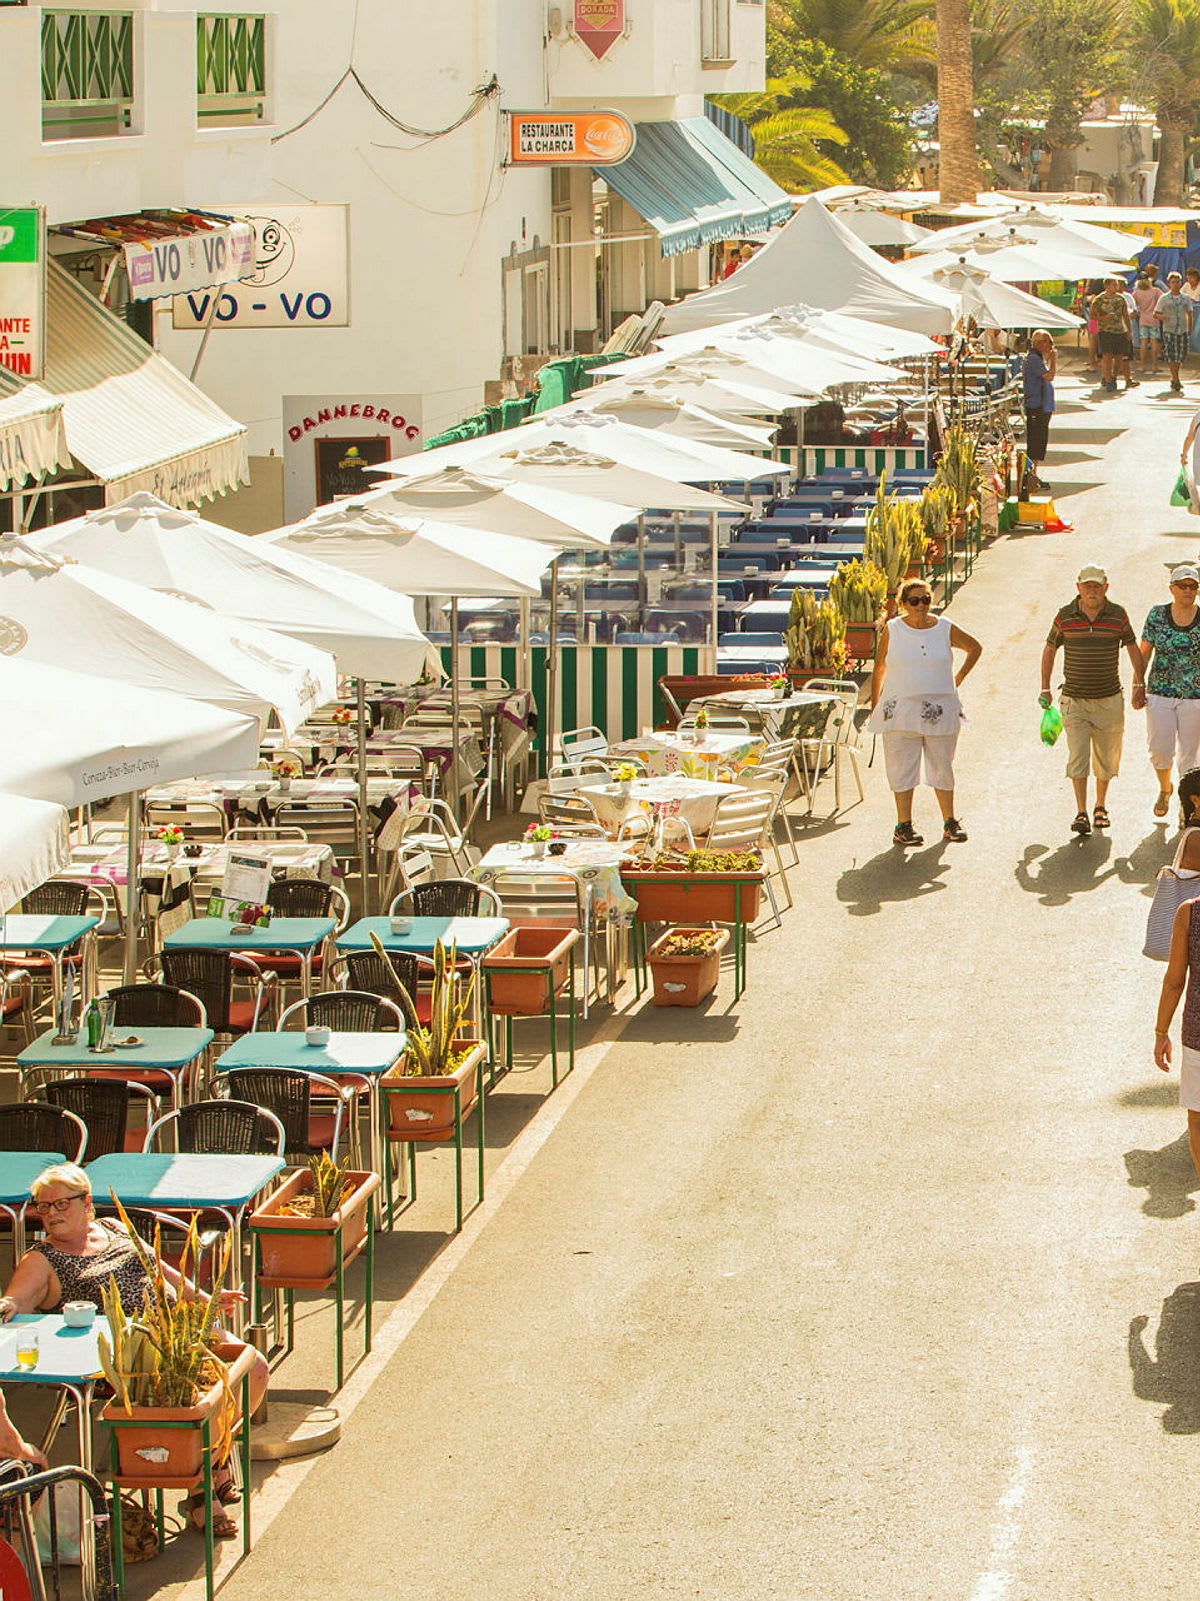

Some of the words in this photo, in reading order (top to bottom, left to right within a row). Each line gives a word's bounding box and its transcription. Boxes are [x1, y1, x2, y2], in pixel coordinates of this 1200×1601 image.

[521, 124, 574, 138] RESTAURANTE
[521, 140, 533, 153] LA
[535, 140, 574, 153] CHARCA
[155, 243, 181, 283] VO
[203, 235, 228, 274] VO
[280, 292, 332, 320] VO
[288, 403, 420, 442] DANNEBROG
